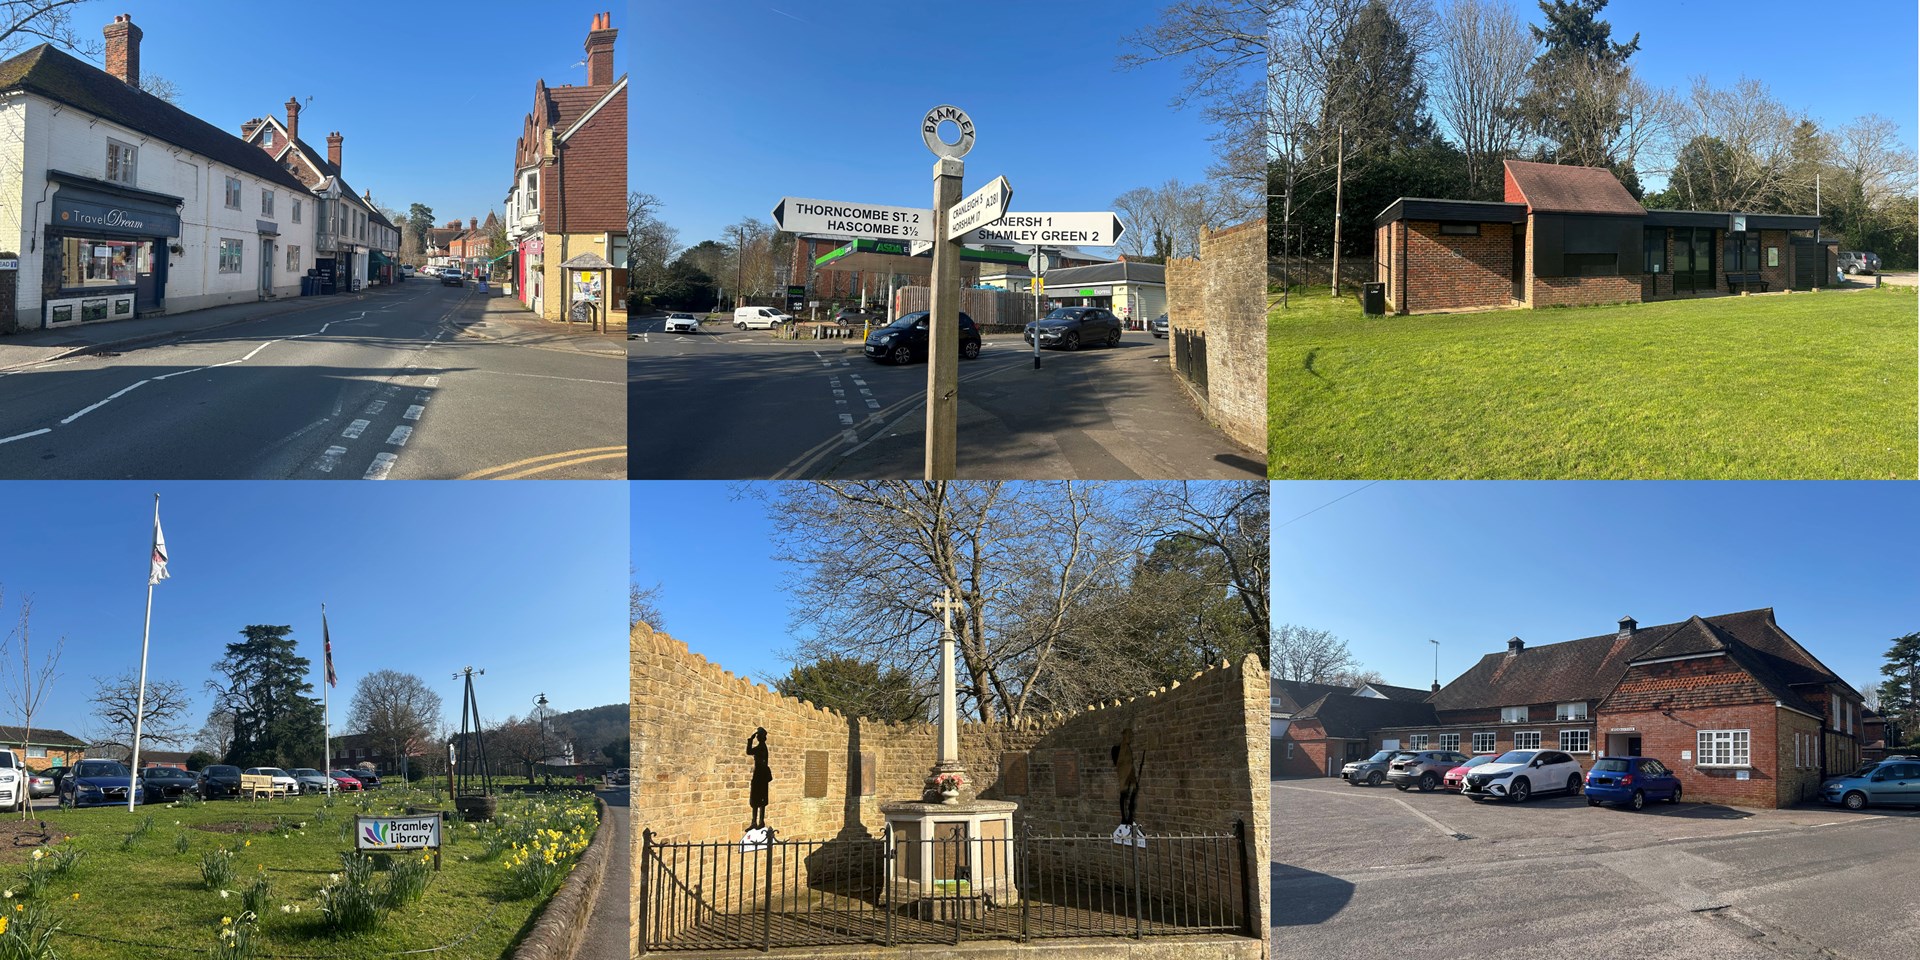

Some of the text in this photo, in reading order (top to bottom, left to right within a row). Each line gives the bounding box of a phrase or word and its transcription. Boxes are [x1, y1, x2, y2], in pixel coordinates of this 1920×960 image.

[925, 108, 975, 139] BRAMLEY
[952, 193, 984, 219] CRANLEIGH 5
[985, 192, 999, 209] A281
[796, 203, 919, 224] THORNCOMBE ST. 2
[986, 216, 1052, 227] ONERSH 1
[827, 220, 919, 237] HASCOMBE 3½
[952, 215, 975, 233] HORSHAM
[978, 230, 1099, 242] SHAMLEY GREEN 2
[876, 243, 903, 254] ASDA
[391, 820, 434, 833] Bramley
[391, 832, 430, 845] Library
